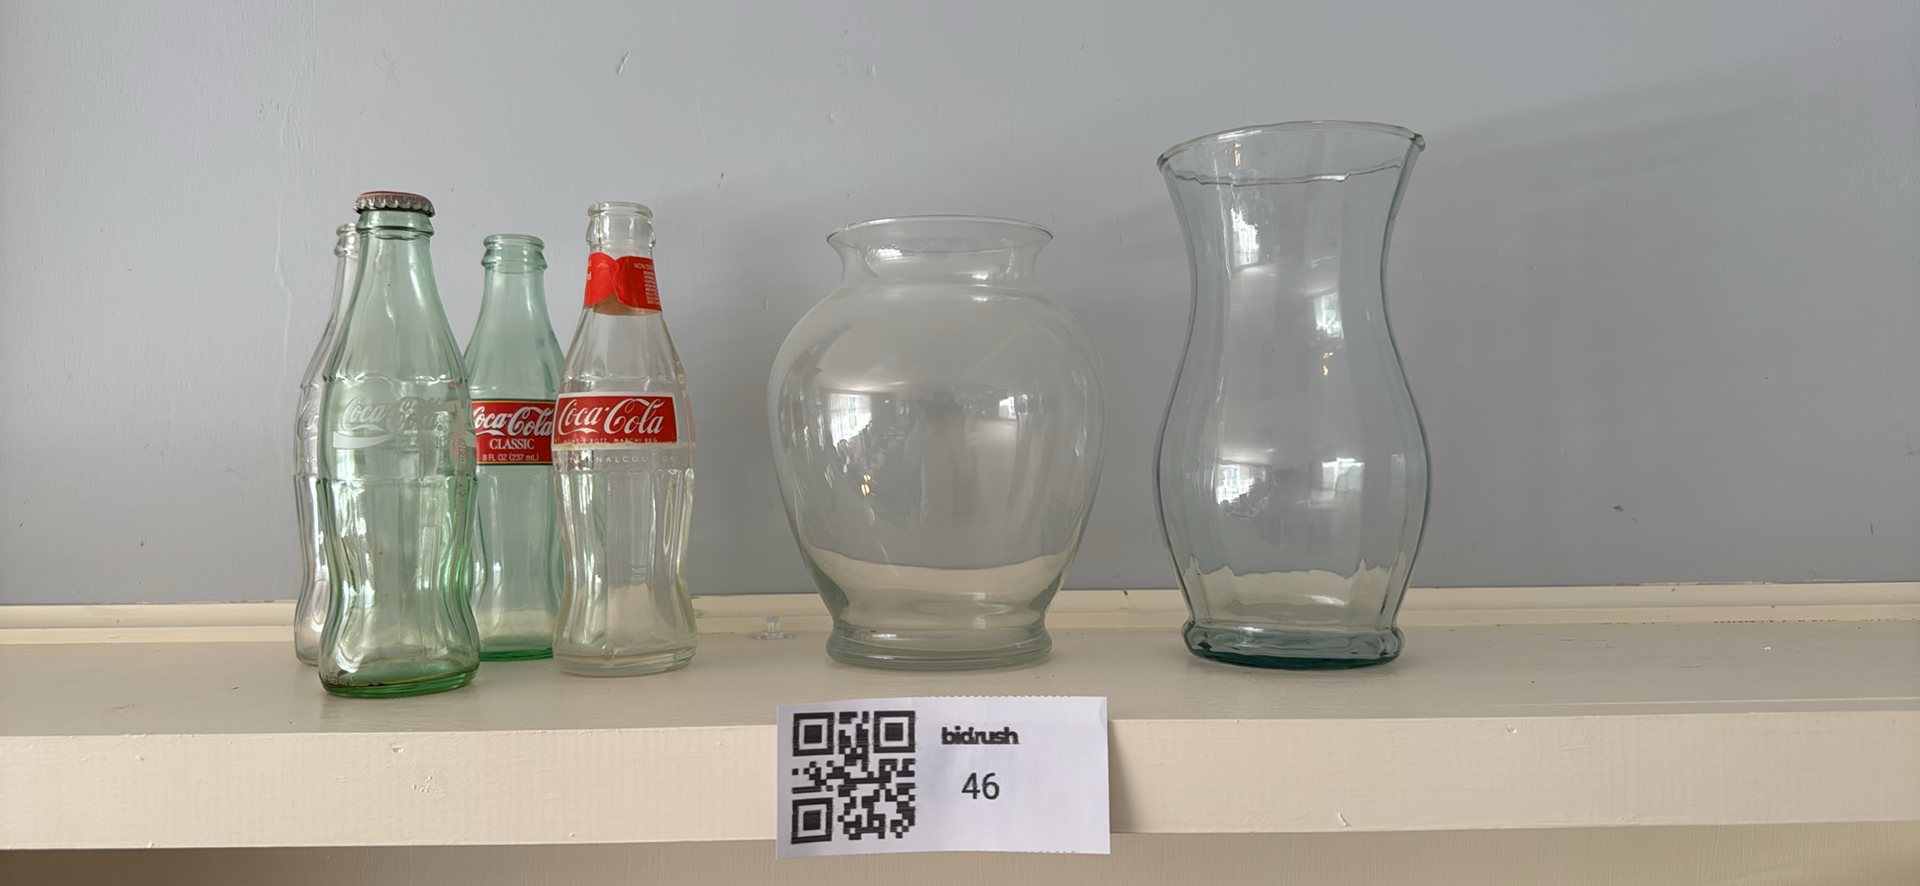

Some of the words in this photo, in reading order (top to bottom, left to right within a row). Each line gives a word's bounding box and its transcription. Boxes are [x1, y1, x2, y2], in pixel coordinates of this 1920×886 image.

[473, 406, 555, 437] Coca-Cola
[558, 398, 665, 436] Coca-Cola
[489, 438, 535, 450] CLASSIC
[482, 453, 488, 461] 8
[497, 453, 508, 461] OZ
[509, 453, 523, 462] (237
[941, 725, 1020, 745] bidrush
[961, 772, 1000, 800] 46
